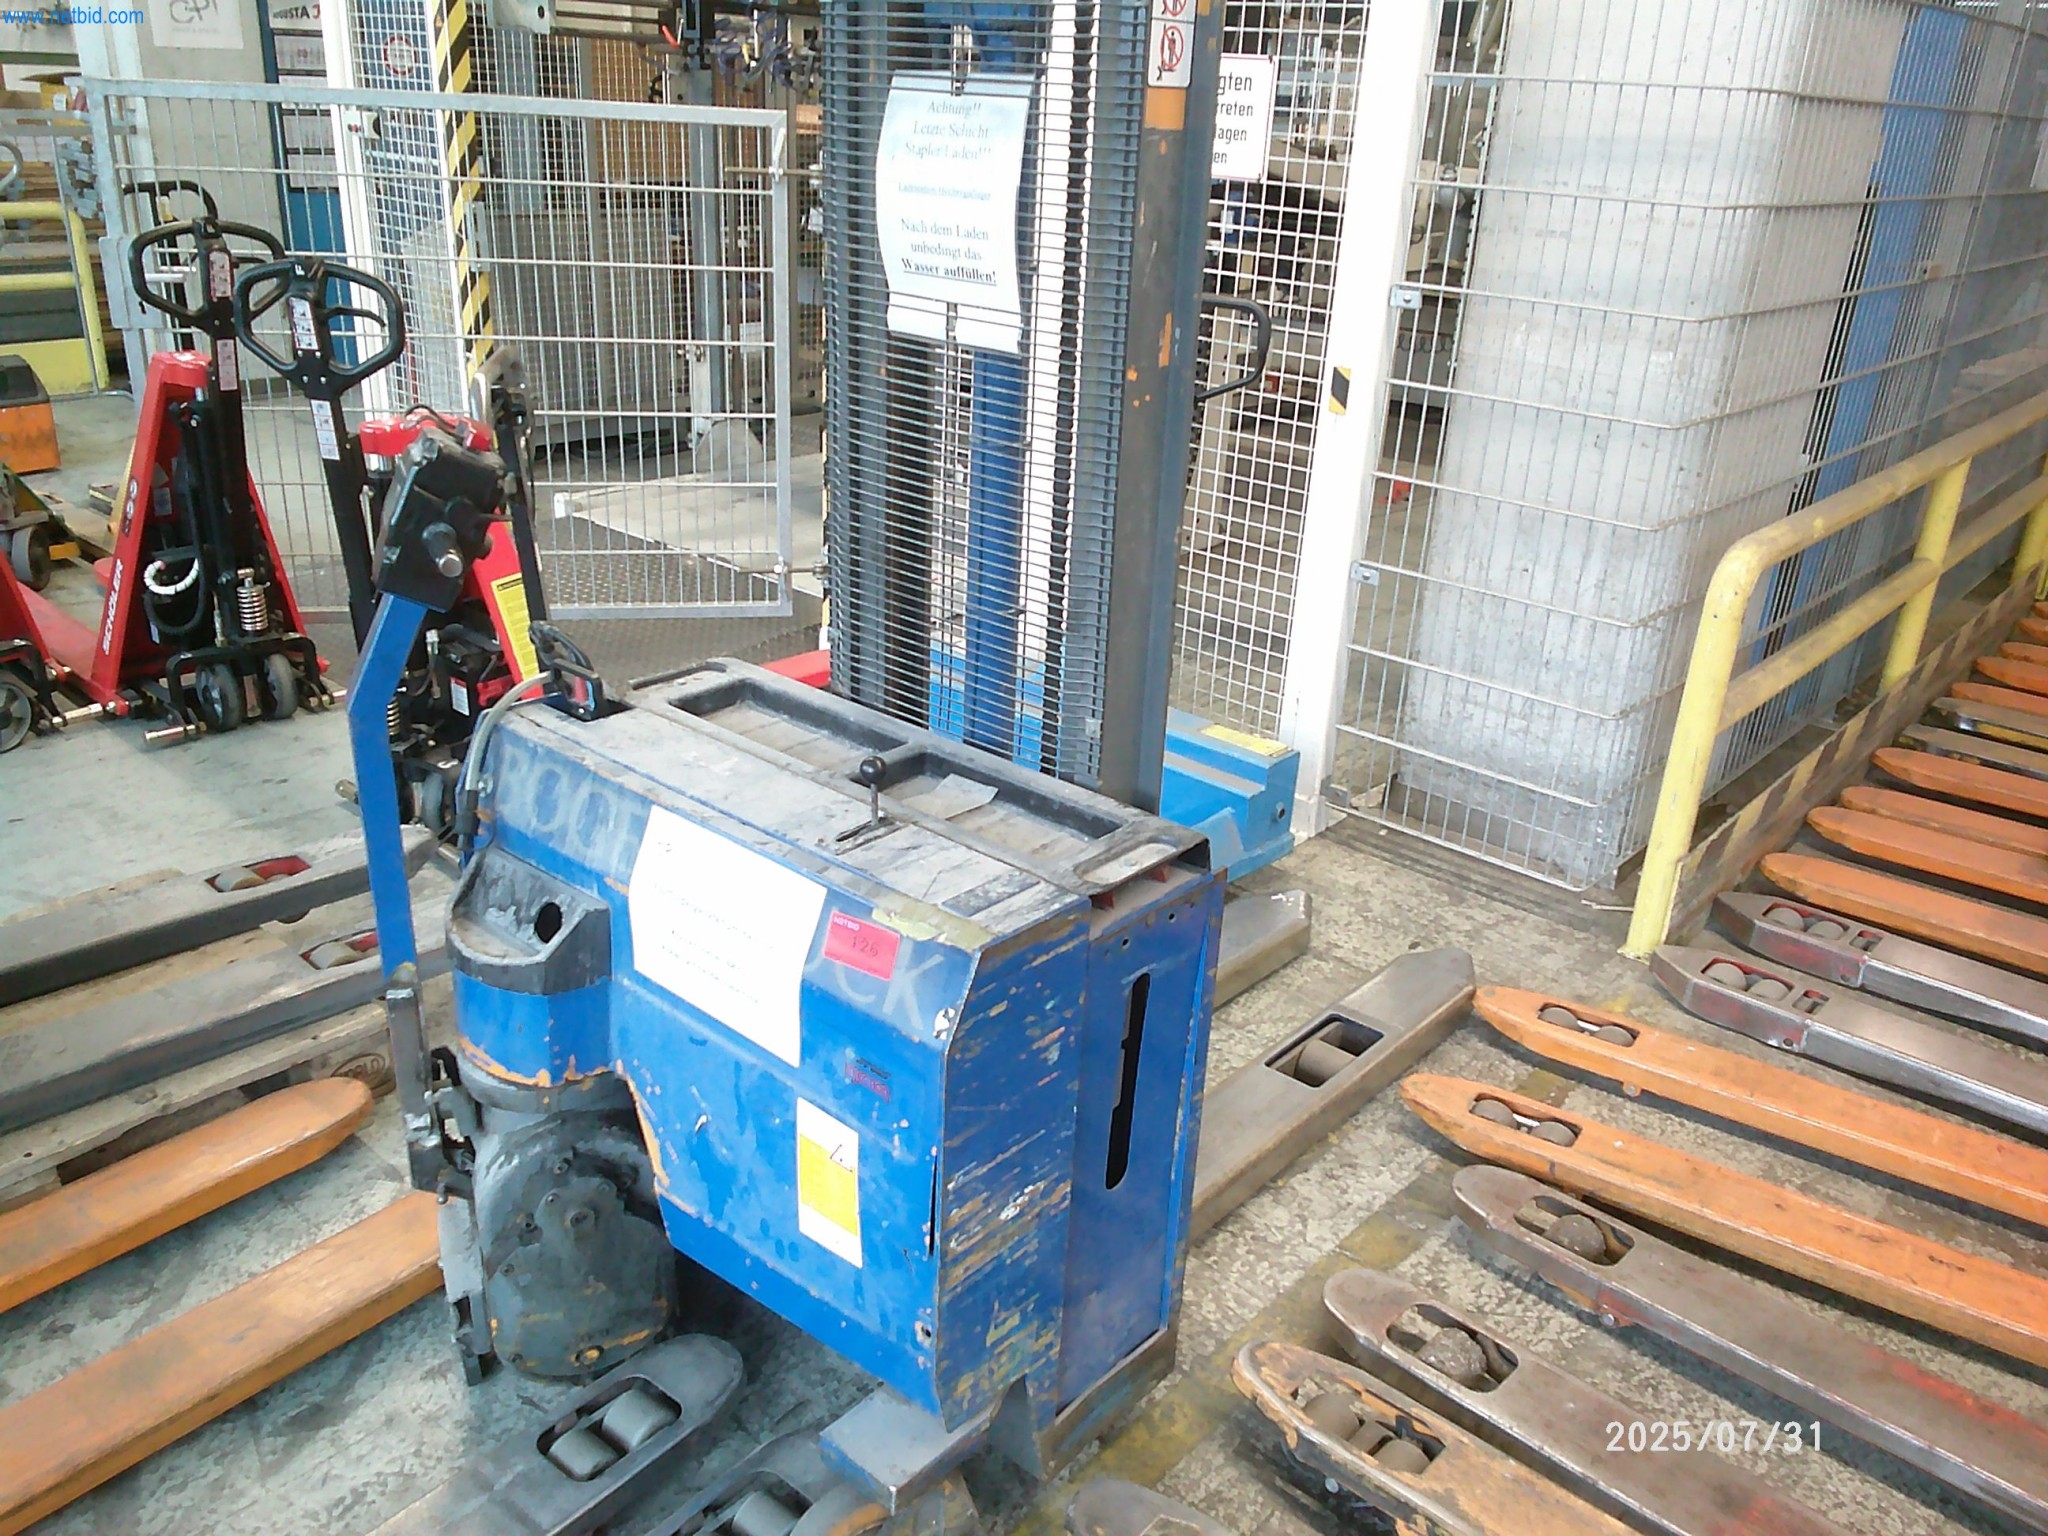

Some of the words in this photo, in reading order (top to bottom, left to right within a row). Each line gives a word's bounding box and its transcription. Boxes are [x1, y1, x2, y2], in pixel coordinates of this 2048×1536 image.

[1217, 72, 1253, 96] gten
[926, 101, 982, 119] Achtung!!
[1217, 101, 1254, 117] reten
[913, 120, 946, 136] Letzte
[949, 122, 989, 139] Schicht
[1217, 127, 1248, 145] agen
[905, 142, 941, 160] Stapler
[1213, 151, 1228, 164] en
[901, 218, 928, 234] Nach
[930, 222, 953, 236] dem
[956, 225, 989, 241] Laden
[911, 241, 961, 261] unbedingt
[964, 247, 982, 261] das
[901, 257, 940, 277] Wasser
[944, 265, 997, 285] auffüllen!
